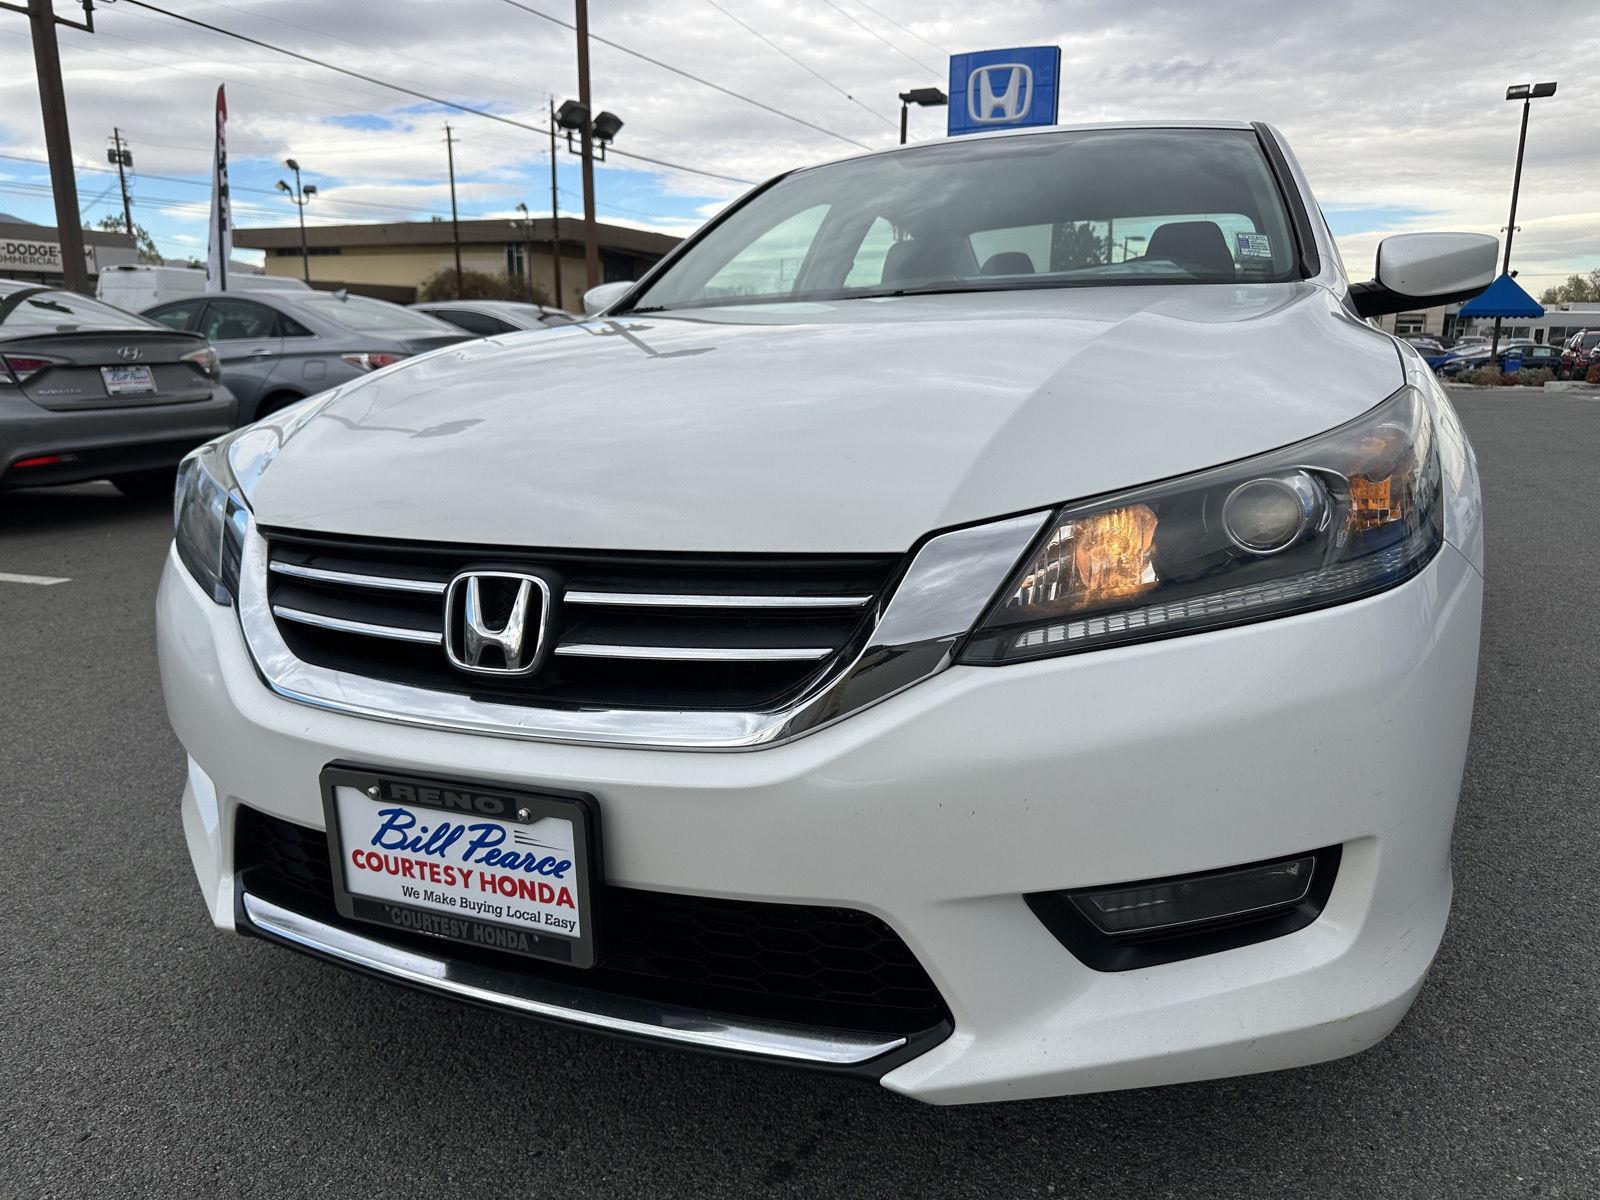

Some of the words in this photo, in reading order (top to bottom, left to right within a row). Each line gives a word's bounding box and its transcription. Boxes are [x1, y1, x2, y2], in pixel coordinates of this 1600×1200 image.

[389, 784, 505, 814] RENO
[371, 808, 466, 858] Bill
[461, 823, 572, 879] Pearce
[352, 849, 473, 888] COURTESY
[479, 872, 576, 909] HONDA
[391, 907, 471, 938] COURTESY
[472, 925, 530, 951] HONDA
[401, 885, 420, 899] We
[423, 889, 457, 906] Make
[459, 897, 503, 917] Buying
[506, 905, 541, 923] Local
[544, 914, 577, 932] Easy
